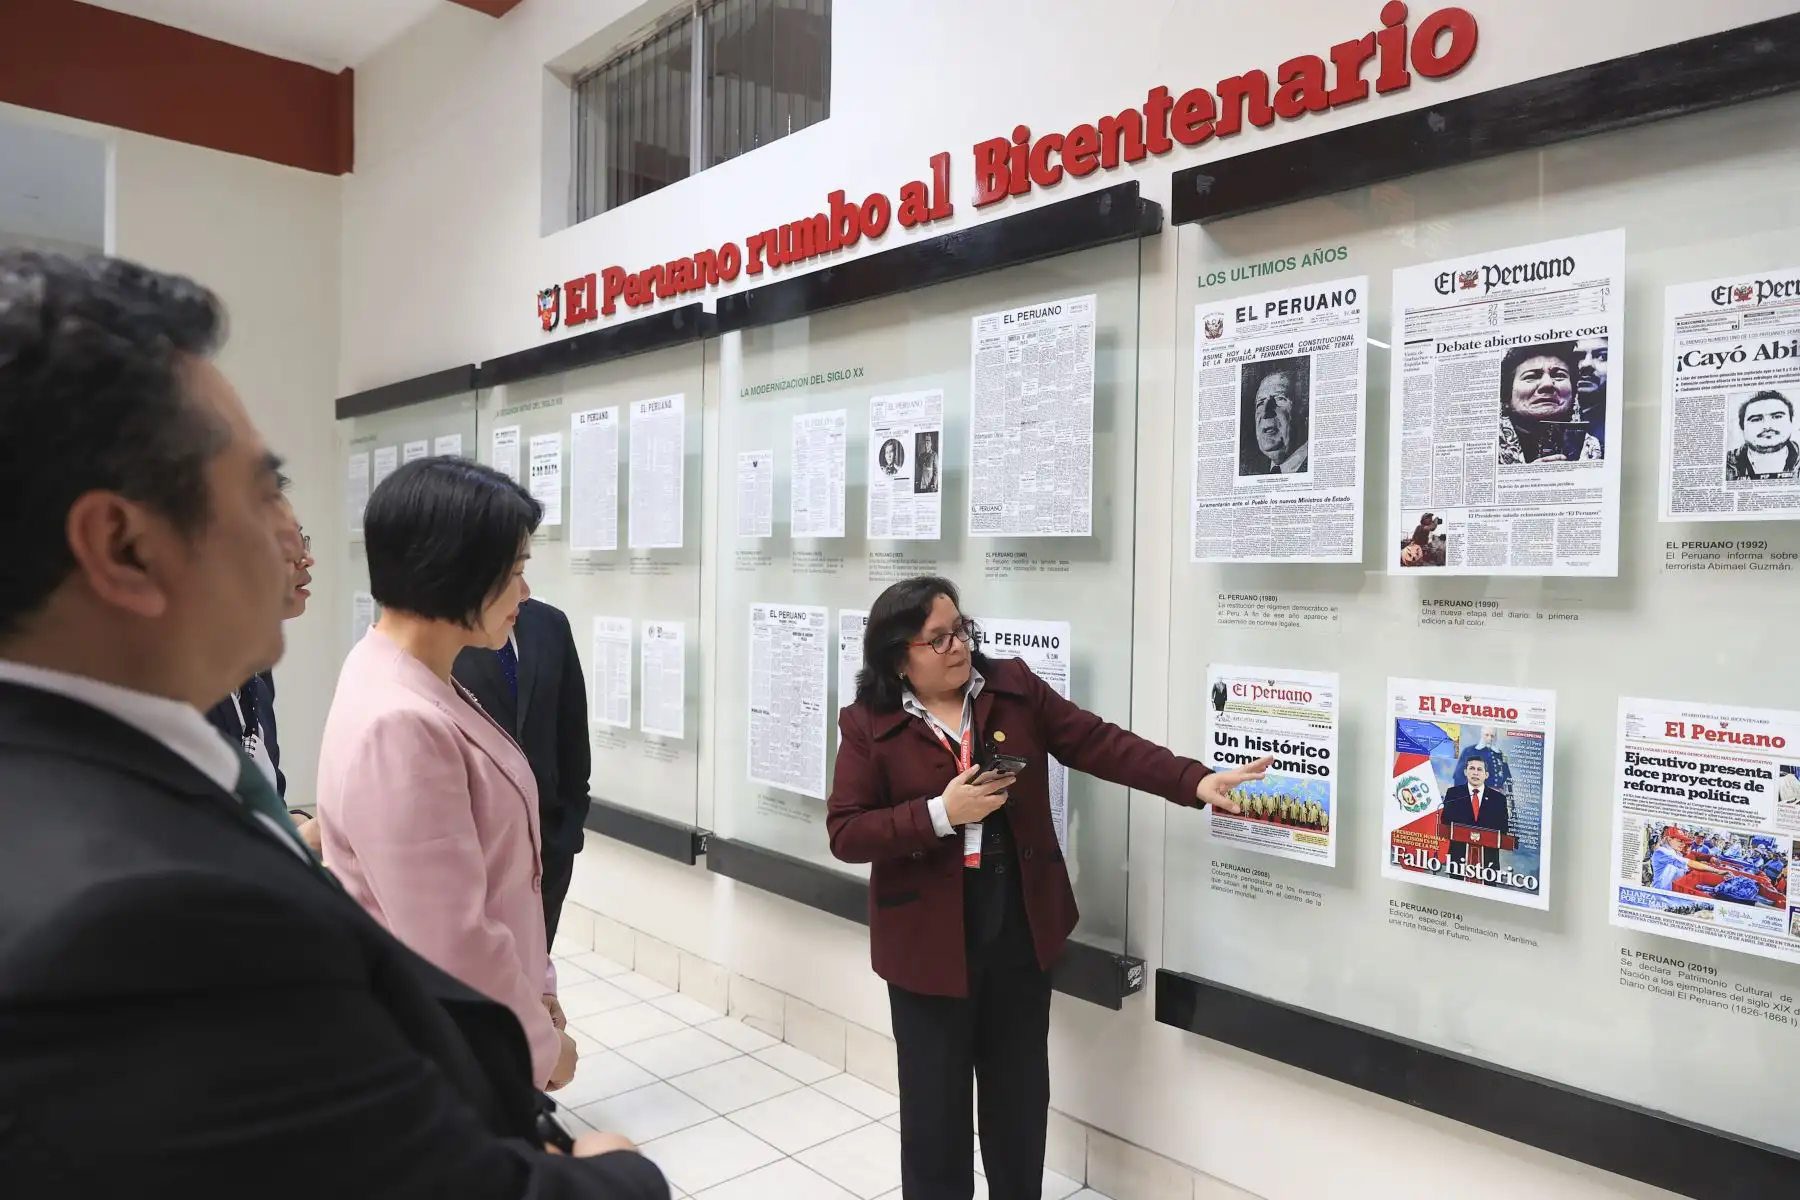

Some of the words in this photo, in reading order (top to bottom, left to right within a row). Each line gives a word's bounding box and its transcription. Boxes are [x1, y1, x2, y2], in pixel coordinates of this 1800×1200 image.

[564, 273, 598, 327] El
[602, 242, 741, 317] Peruano
[746, 189, 891, 275] rumbo
[898, 151, 953, 228] al
[973, 0, 1478, 208] Bicentenario
[1198, 271, 1226, 288] LOS
[1231, 257, 1296, 282] ULTIMOS
[1301, 246, 1348, 268] AÑOS
[1435, 271, 1456, 295] El
[1482, 256, 1575, 295] Peruano
[1235, 306, 1258, 324] EL
[1265, 288, 1357, 318] PERUANO
[1712, 285, 1733, 305] El
[1004, 315, 1014, 324] EL
[1018, 306, 1061, 321] PERUANO
[1256, 343, 1294, 352] PRESIDENCIA
[1298, 334, 1354, 347] CONSTITUCIONAL
[1261, 349, 1293, 358] FERNANDO
[1298, 344, 1330, 353] BELAUNDE
[1436, 341, 1482, 354] Debate
[1485, 334, 1532, 348] abierto
[1534, 330, 1573, 343] sobre
[1576, 326, 1608, 337] coca
[1677, 345, 1746, 372] ¡Cayó
[1752, 340, 1800, 361] Abi
[740, 388, 749, 397] LA
[811, 374, 824, 385] DEL
[827, 369, 851, 382] SIGLO
[854, 367, 864, 378] XX
[1736, 541, 1768, 550] (1992)
[779, 611, 806, 620] PERUANO
[1548, 613, 1578, 622] primera
[995, 632, 1060, 648] PERUANO
[1233, 683, 1247, 697] El
[1251, 684, 1312, 703] Peruano
[1419, 696, 1435, 712] El
[1440, 698, 1518, 720] Peruano
[1215, 732, 1238, 748] Un
[1245, 736, 1330, 759] histórico
[1665, 721, 1685, 738] El
[1691, 723, 1786, 748] Peruano
[1214, 751, 1330, 776] comomiso
[1625, 751, 1697, 770] Ejecutivo
[1700, 762, 1772, 780] presenta
[1625, 766, 1660, 779] doce
[1662, 771, 1741, 790] proyectos
[1744, 778, 1764, 792] de
[1624, 780, 1685, 796] reforma
[1688, 788, 1750, 805] política
[1221, 863, 1250, 874] PERUANO
[1392, 844, 1440, 871] Fallo
[1445, 854, 1539, 890] histórico
[1621, 890, 1656, 900] ALIANZA
[1389, 908, 1414, 920] Edición
[1401, 901, 1438, 916] PERUANO
[1441, 910, 1463, 922] (2014)
[1418, 922, 1437, 934] hacia
[1621, 948, 1633, 957] EL
[1636, 951, 1685, 968] PERUANO
[1688, 962, 1718, 976] (2019)
[1620, 968, 1650, 981] Nación
[1661, 978, 1674, 987] los
[1676, 981, 1727, 999] ejemplares
[1730, 993, 1744, 1003] del
[1747, 996, 1770, 1009] siglo
[1773, 1002, 1791, 1014] XIX
[1621, 958, 1632, 967] Se
[1639, 961, 1672, 976] declara
[1678, 971, 1728, 988] Patrimonio
[1734, 983, 1773, 998] Cultural
[1780, 993, 1792, 1003] de
[1620, 978, 1645, 990] Diario
[1647, 984, 1675, 997] Oficial
[1678, 991, 1687, 999] El
[1690, 993, 1729, 1010] Peruano
[1732, 1004, 1788, 1024] (1826-1868
